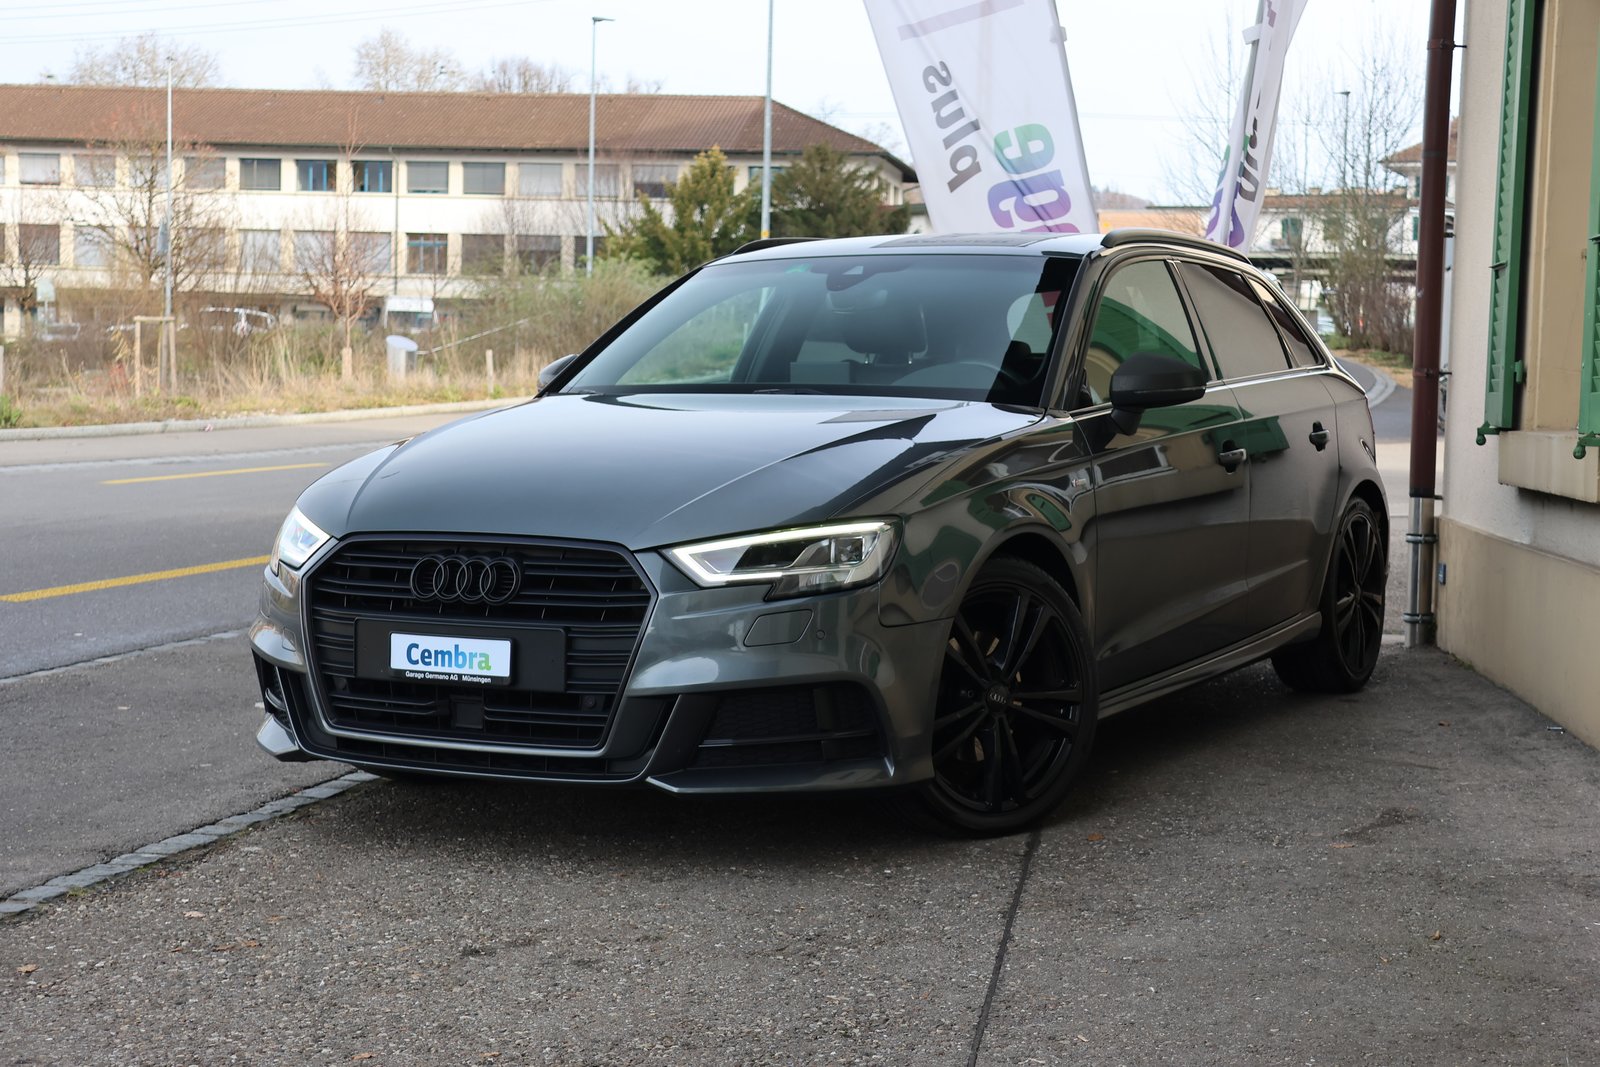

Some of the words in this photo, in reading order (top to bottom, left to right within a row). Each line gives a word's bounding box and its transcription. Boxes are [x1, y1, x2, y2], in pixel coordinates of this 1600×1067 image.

[406, 642, 492, 671] Cembra
[405, 671, 424, 679] Garage
[425, 672, 449, 680] Germano
[462, 675, 491, 684] Münsingen
